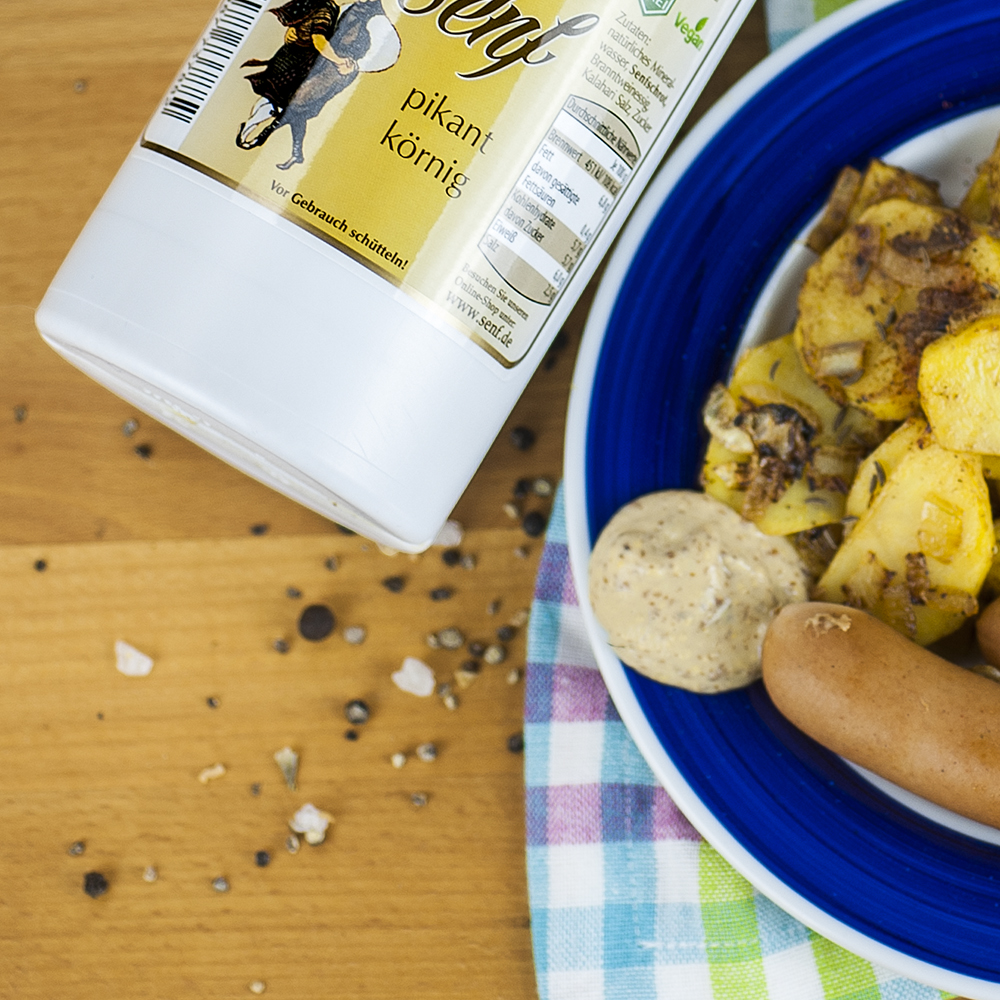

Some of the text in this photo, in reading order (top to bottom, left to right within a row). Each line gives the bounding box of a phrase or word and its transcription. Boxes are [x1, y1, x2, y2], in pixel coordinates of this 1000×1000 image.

[607, 27, 651, 67] natürliches
[615, 11, 652, 46] Zutaten:
[674, 11, 705, 51] Vegan
[599, 41, 629, 72] wasser,
[582, 66, 619, 100] Kalahari
[400, 87, 494, 155] pikant
[379, 118, 470, 199] körnig
[538, 144, 555, 162] Fett
[547, 128, 583, 162] Brennwert
[531, 161, 553, 182] davon
[270, 179, 409, 271] Vor Gebrauch schütteln!
[504, 206, 525, 227] davon
[523, 220, 545, 244] Zucker
[511, 190, 556, 230] Kohlenhydrate
[483, 235, 500, 253] Salz
[492, 219, 518, 243] Eiweiß
[454, 275, 500, 316] Online-Shop
[462, 262, 497, 295] Besuchen
[496, 288, 509, 303] Sie
